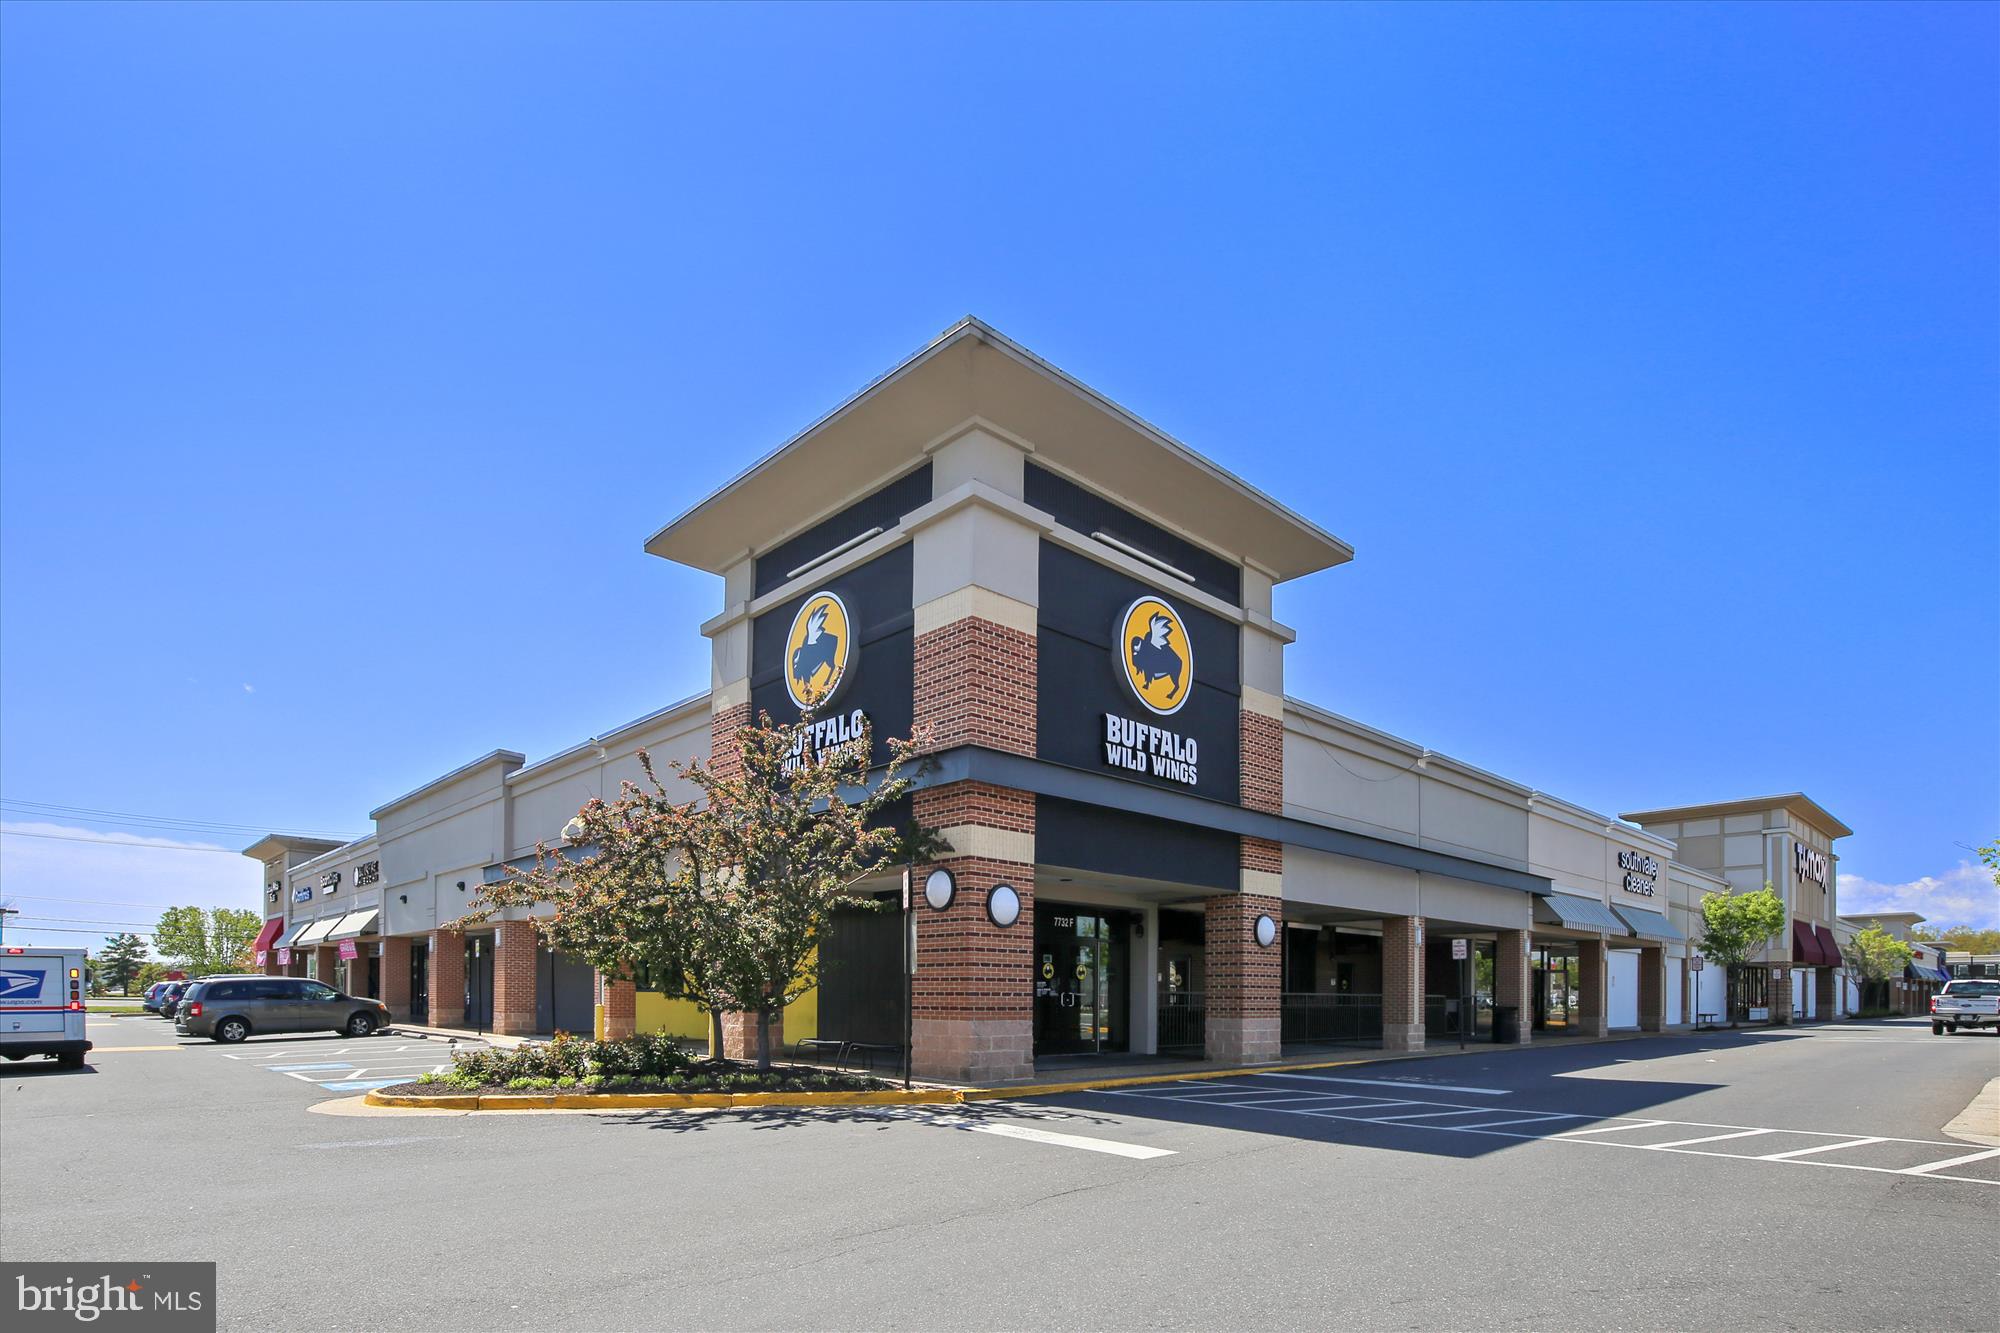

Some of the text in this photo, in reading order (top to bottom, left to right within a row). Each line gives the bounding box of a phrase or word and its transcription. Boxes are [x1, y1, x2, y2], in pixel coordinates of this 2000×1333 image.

[783, 708, 865, 758] UFALO
[1105, 713, 1198, 765] BUFFALO
[1105, 742, 1198, 785] WILD WINGS
[1626, 872, 1655, 897] cleaners
[1053, 916, 1069, 928] 7732
